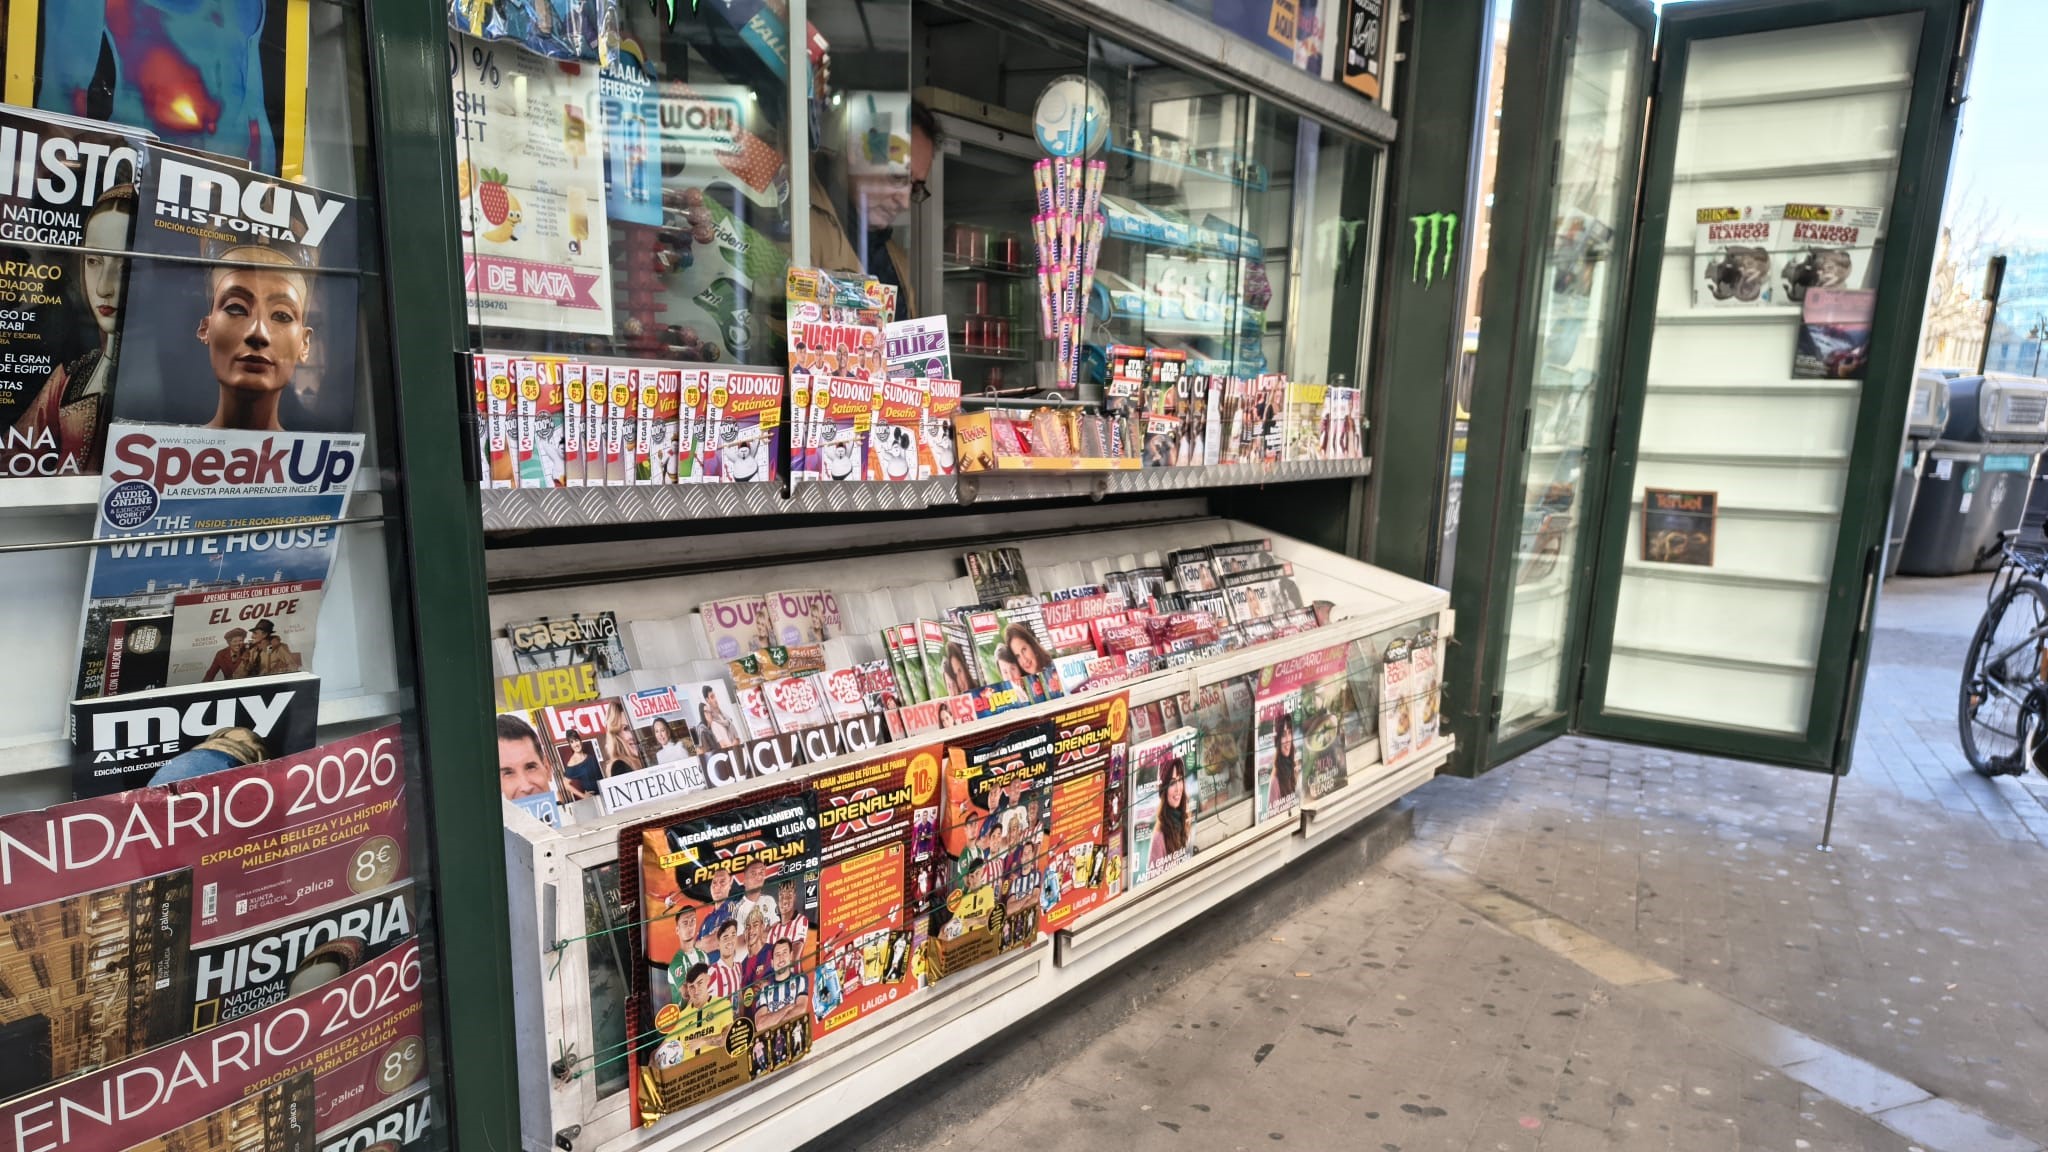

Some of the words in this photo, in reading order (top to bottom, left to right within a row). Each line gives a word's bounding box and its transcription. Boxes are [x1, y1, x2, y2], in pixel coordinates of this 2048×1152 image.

[157, 158, 346, 248] muy
[3, 204, 82, 230] NATIONAL
[155, 202, 297, 244] HISTORIA
[154, 219, 186, 233] EDICIÓN
[186, 223, 238, 244] COLECCIONISTA
[710, 222, 753, 253] Trident
[1708, 229, 1770, 241] BLANCOS
[1793, 229, 1859, 243] BLANCOS
[487, 264, 518, 293] DE
[522, 268, 577, 299] NATA
[19, 294, 28, 304] A
[30, 295, 62, 305] ROMA
[21, 311, 36, 321] DE
[793, 322, 863, 354] JUGÓN!
[5, 354, 16, 363] EL
[20, 354, 50, 364] GRAN
[15, 365, 52, 375] EGIPTO
[728, 375, 781, 396] SUDOKU
[830, 380, 874, 402] SUDOKU
[883, 383, 924, 407] SUDOKU
[930, 381, 961, 398] SUDOKU
[731, 396, 776, 413] Satánico
[831, 401, 868, 414] Satánico
[885, 406, 917, 418] Desafío
[958, 425, 988, 444] Twix
[110, 496, 153, 508] ONLINE
[115, 490, 150, 500] AUDIO
[167, 487, 179, 496] LA
[181, 487, 217, 496] REVISTA
[218, 486, 242, 495] PARA
[243, 485, 288, 495] APRENDER
[289, 484, 318, 494] INGLÉS
[115, 510, 138, 519] WORK
[118, 517, 142, 526] OUT!
[154, 515, 192, 530] THE
[194, 519, 227, 528] INSIDE
[229, 518, 248, 527] THE
[249, 516, 285, 526] ROOMS
[109, 531, 219, 559] WHITE
[226, 525, 329, 553] HOUSE
[203, 593, 230, 603] APRENDE
[230, 590, 250, 601] INGLÉS
[250, 588, 263, 599] CON
[264, 588, 271, 598] EL
[271, 585, 290, 597] MEJOR
[290, 584, 303, 594] CINE
[208, 607, 232, 626] EL
[238, 598, 300, 622] GOLPE
[502, 663, 599, 709] MUEBLE
[628, 687, 682, 719] SEMANA
[905, 693, 973, 731] PATRES
[92, 691, 298, 753] muy
[93, 741, 181, 764] ARTE
[93, 765, 122, 777] EDICIÓN
[123, 759, 172, 775] COLECCIONISTA
[286, 737, 397, 817] 2026
[820, 776, 837, 789] GRAN
[837, 771, 855, 785] JUEGO
[855, 770, 862, 779] DE
[862, 764, 882, 779] FÚTBOL
[882, 763, 889, 771] DE
[201, 839, 262, 866] EXPLORA
[263, 835, 278, 852] LA
[280, 822, 329, 846] BELLEZA
[329, 820, 339, 832] Y
[340, 814, 353, 828] LA
[354, 799, 399, 821] HISTORIA
[678, 825, 730, 847] MEGAPACK
[731, 823, 743, 834] de
[744, 806, 804, 831] LANZAMIENTO
[776, 821, 807, 839] LALIGA
[242, 846, 310, 869] MILENARIA
[311, 838, 327, 852] DE
[330, 823, 370, 845] GALICIA
[355, 843, 391, 884] 8€
[694, 838, 806, 885] ADRENALYN
[249, 892, 274, 904] XUNTA
[259, 894, 288, 909] GALICIA
[285, 878, 335, 907] galicia
[195, 895, 411, 1002] HISTORIA
[223, 980, 287, 1008] NATIONAL
[320, 946, 422, 1037] 2026
[861, 992, 888, 1013] LALIGA
[344, 1048, 359, 1062] DE
[360, 1027, 399, 1051] GALICIA
[243, 1064, 298, 1097] EXPLORA
[300, 1057, 314, 1071] LA
[315, 1036, 360, 1062] BELLEZA
[360, 1029, 369, 1039] Y
[369, 1025, 382, 1037] LA
[384, 1042, 417, 1083] 8€
